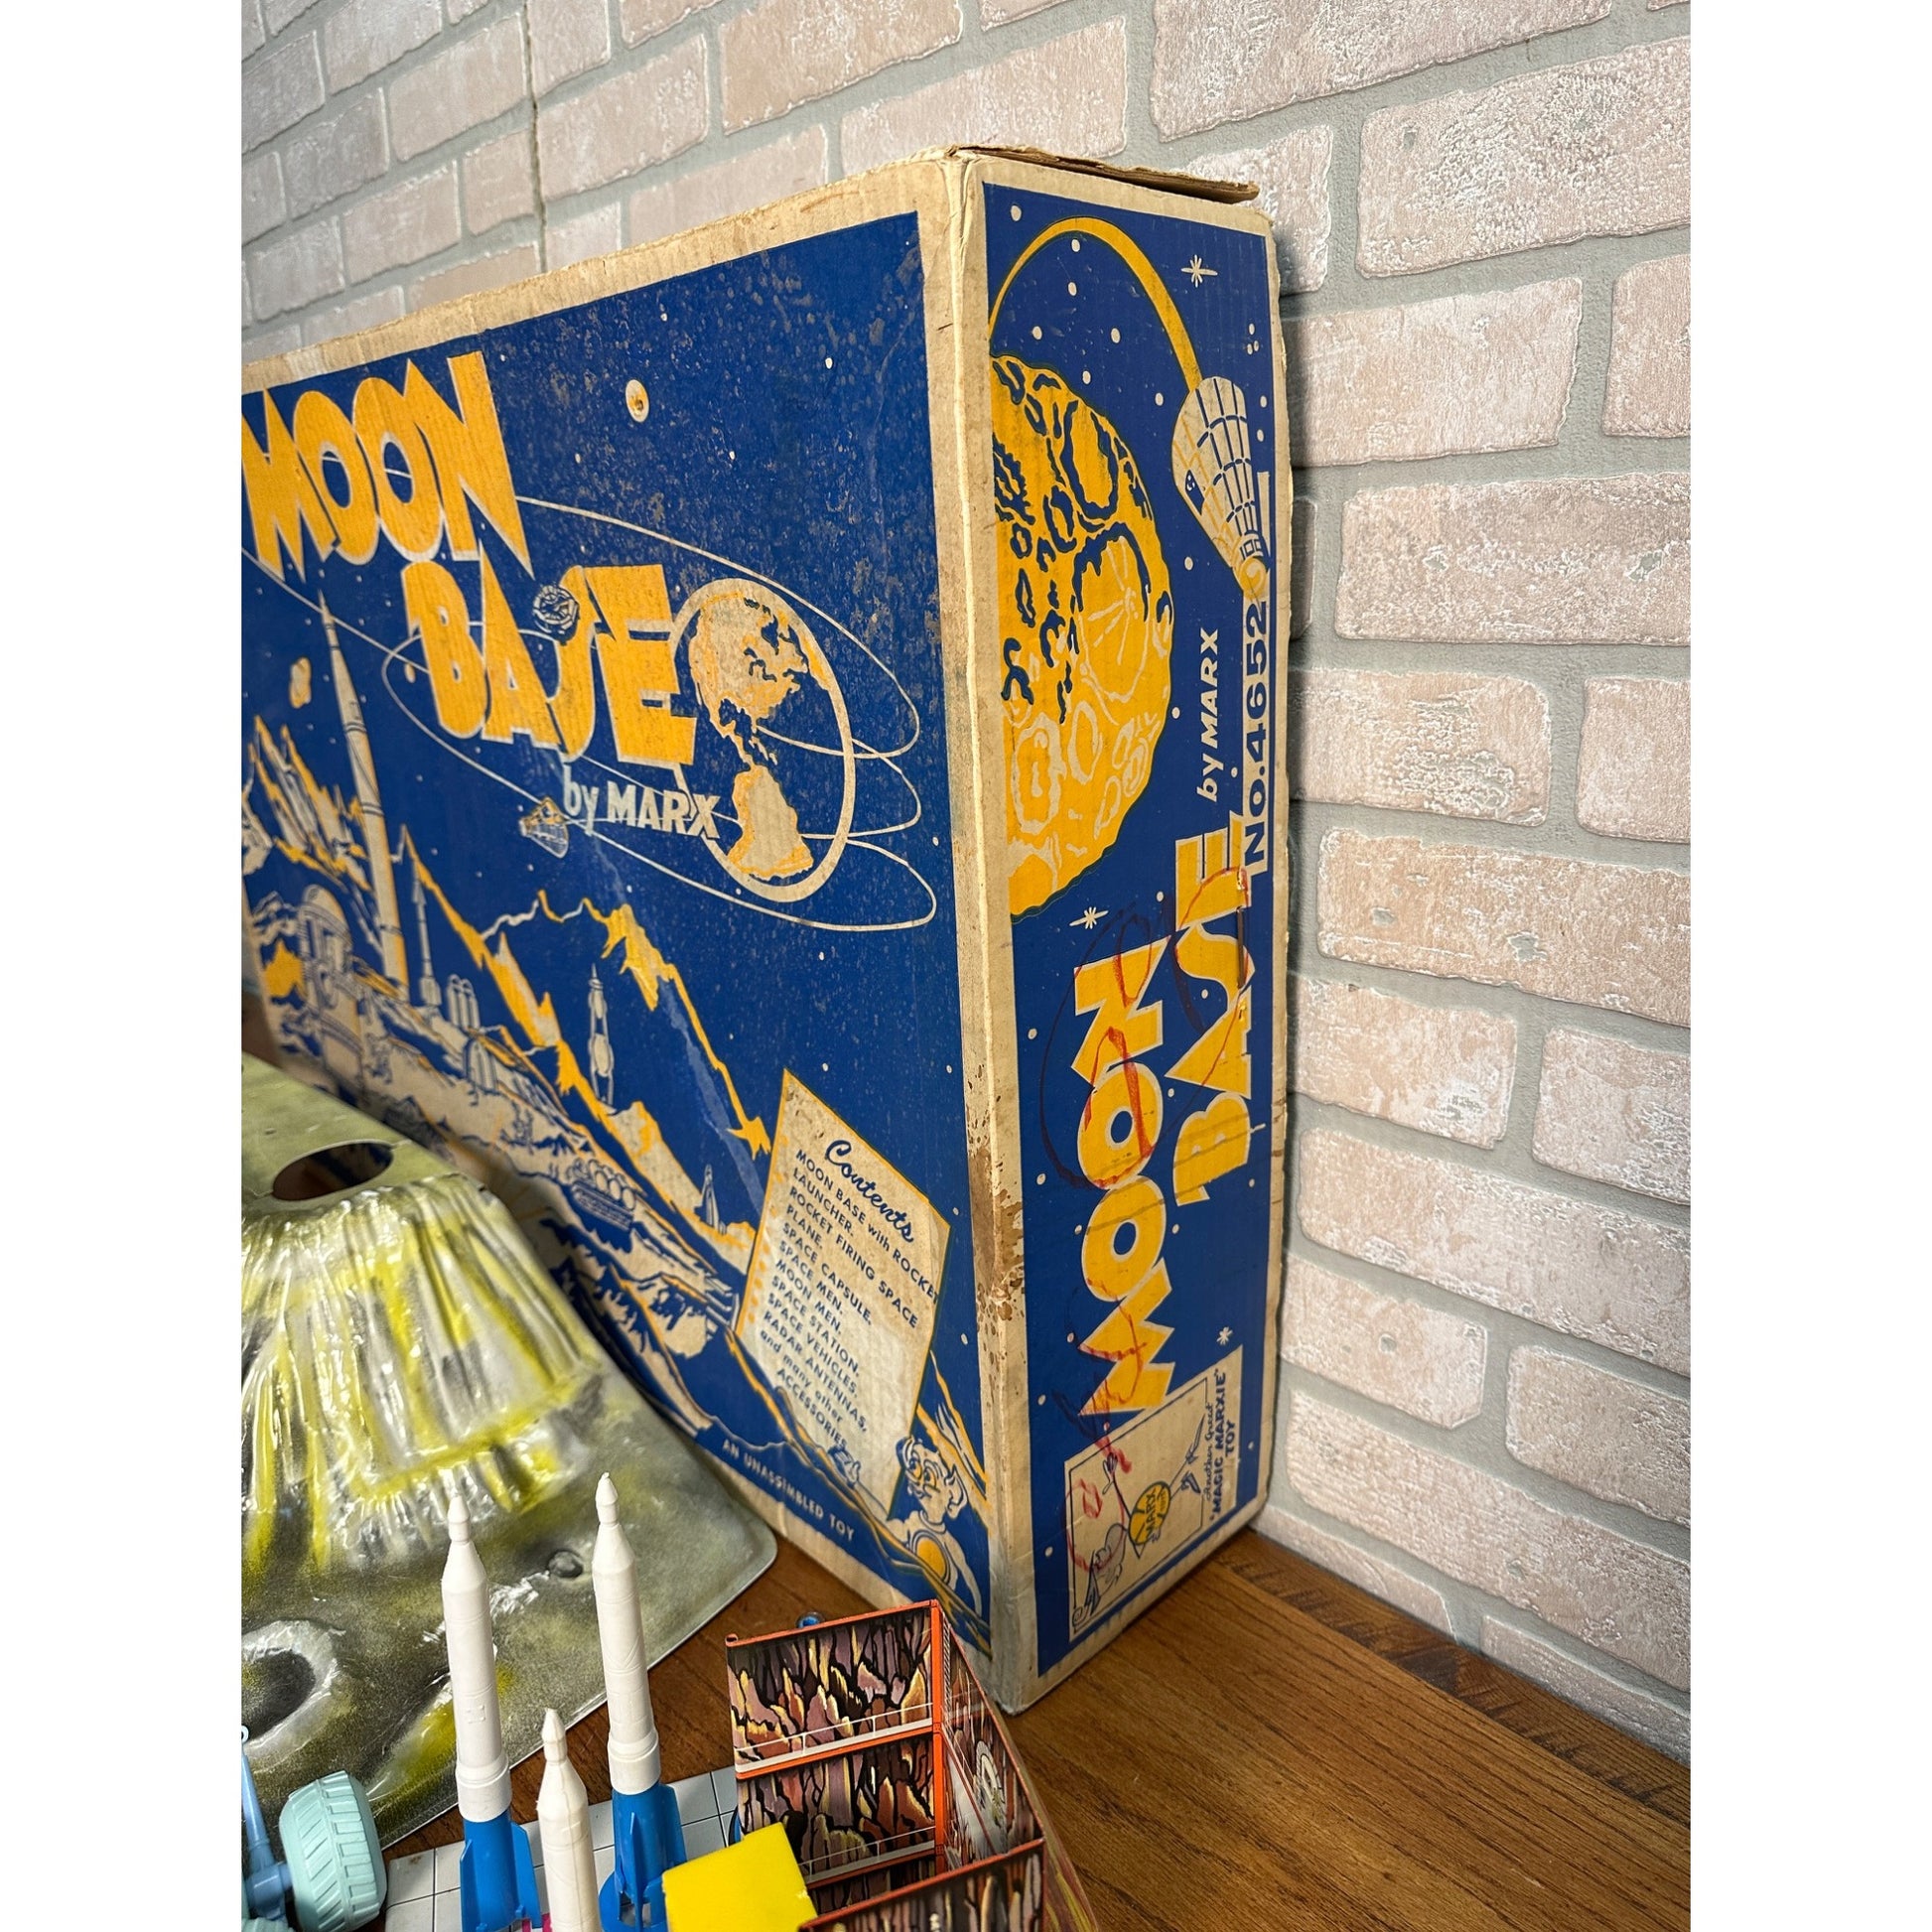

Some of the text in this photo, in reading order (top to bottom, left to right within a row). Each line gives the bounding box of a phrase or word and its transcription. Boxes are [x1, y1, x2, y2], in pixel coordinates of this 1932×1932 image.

[241, 350, 535, 584] MOON
[401, 540, 697, 767] BASE
[1196, 626, 1224, 802] by MARX
[563, 763, 721, 840] by MARX
[1165, 810, 1256, 1207] BASE
[792, 1167, 854, 1237] LAUNCHER.
[795, 1149, 834, 1191] MOON
[836, 1189, 866, 1224] BASE
[868, 1222, 890, 1252] with
[825, 1140, 913, 1242] Contents
[1070, 935, 1175, 1416] MOON
[782, 1222, 872, 1325] SPACE CAPSULE.
[786, 1204, 823, 1249] PLANE.
[789, 1186, 918, 1328] ROCKET FIRING SPACE
[767, 1293, 803, 1334] SPACE
[771, 1276, 860, 1377] SPACE STATION.
[776, 1260, 841, 1335] MOON MEN.
[779, 1241, 843, 1314] SPACE MEN.
[759, 1329, 844, 1423] and many other
[764, 1311, 868, 1432] RADAR ANTENNAS,
[776, 1368, 848, 1449] ACCESSORIES
[1203, 1402, 1213, 1500] Another Great
[1225, 1420, 1236, 1457] TOY
[723, 1439, 740, 1459] AN
[830, 1513, 855, 1541] TOY
